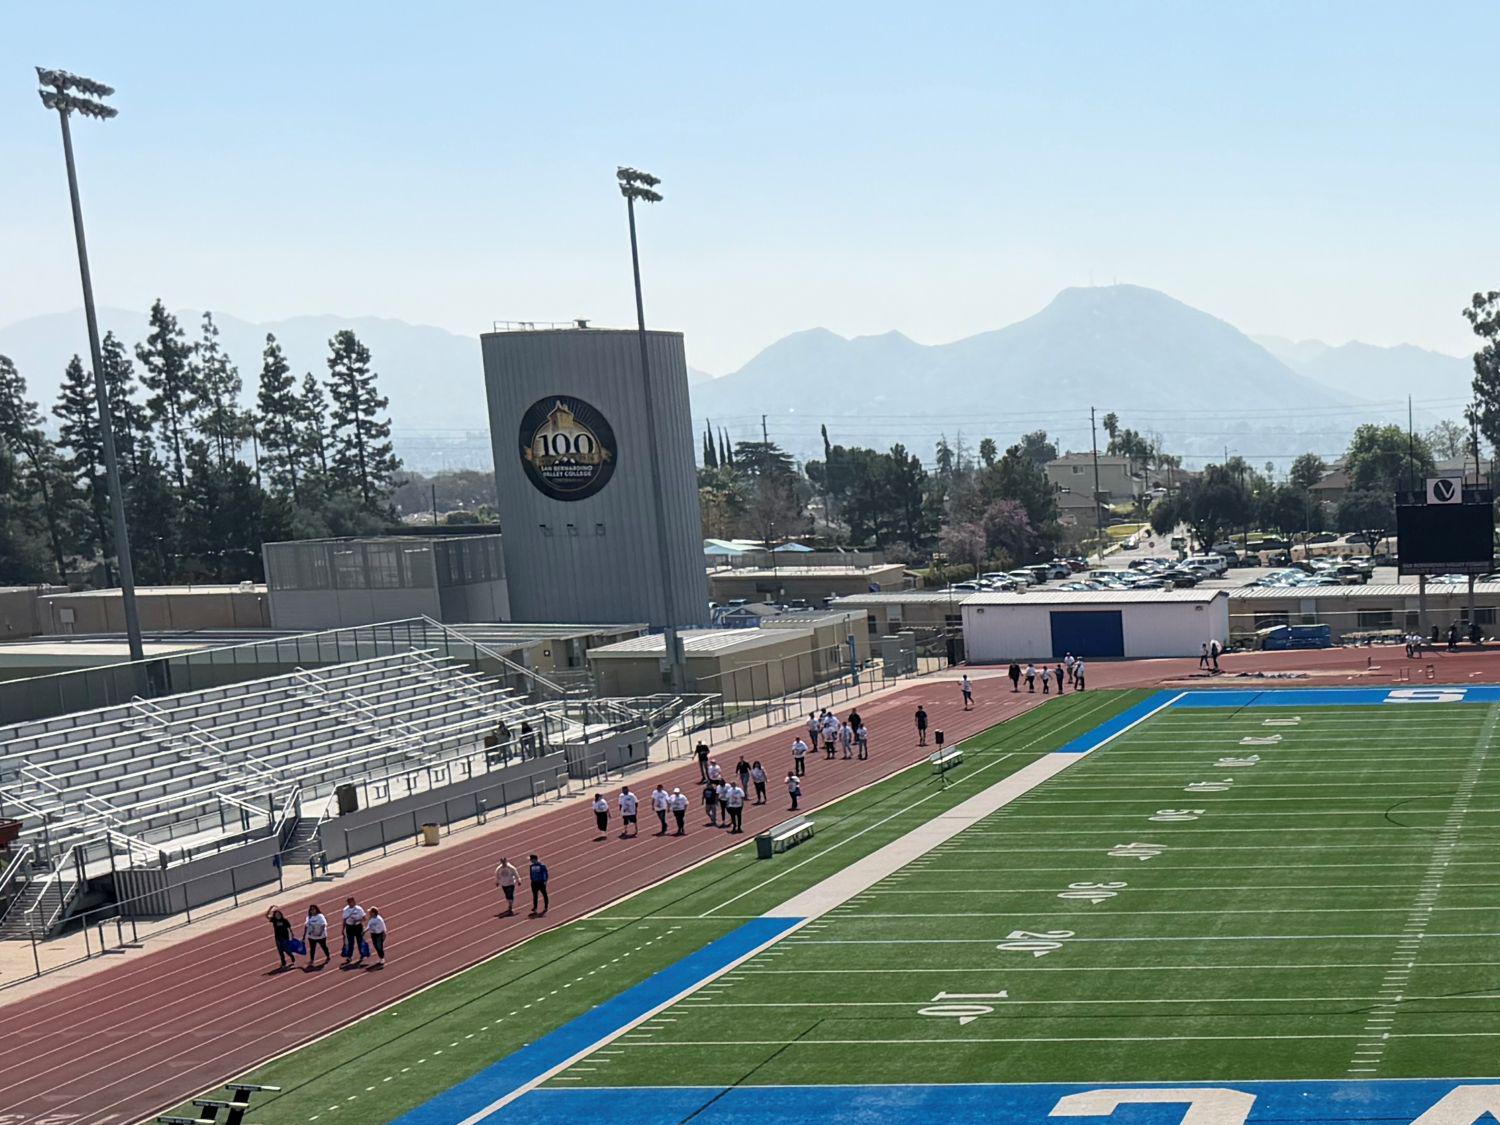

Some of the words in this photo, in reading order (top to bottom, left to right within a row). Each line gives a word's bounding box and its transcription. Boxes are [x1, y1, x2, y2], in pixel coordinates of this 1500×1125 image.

[538, 432, 594, 456] 100
[1056, 881, 1128, 899] 30
[996, 930, 1075, 951] 20
[917, 990, 1009, 1016] 10
